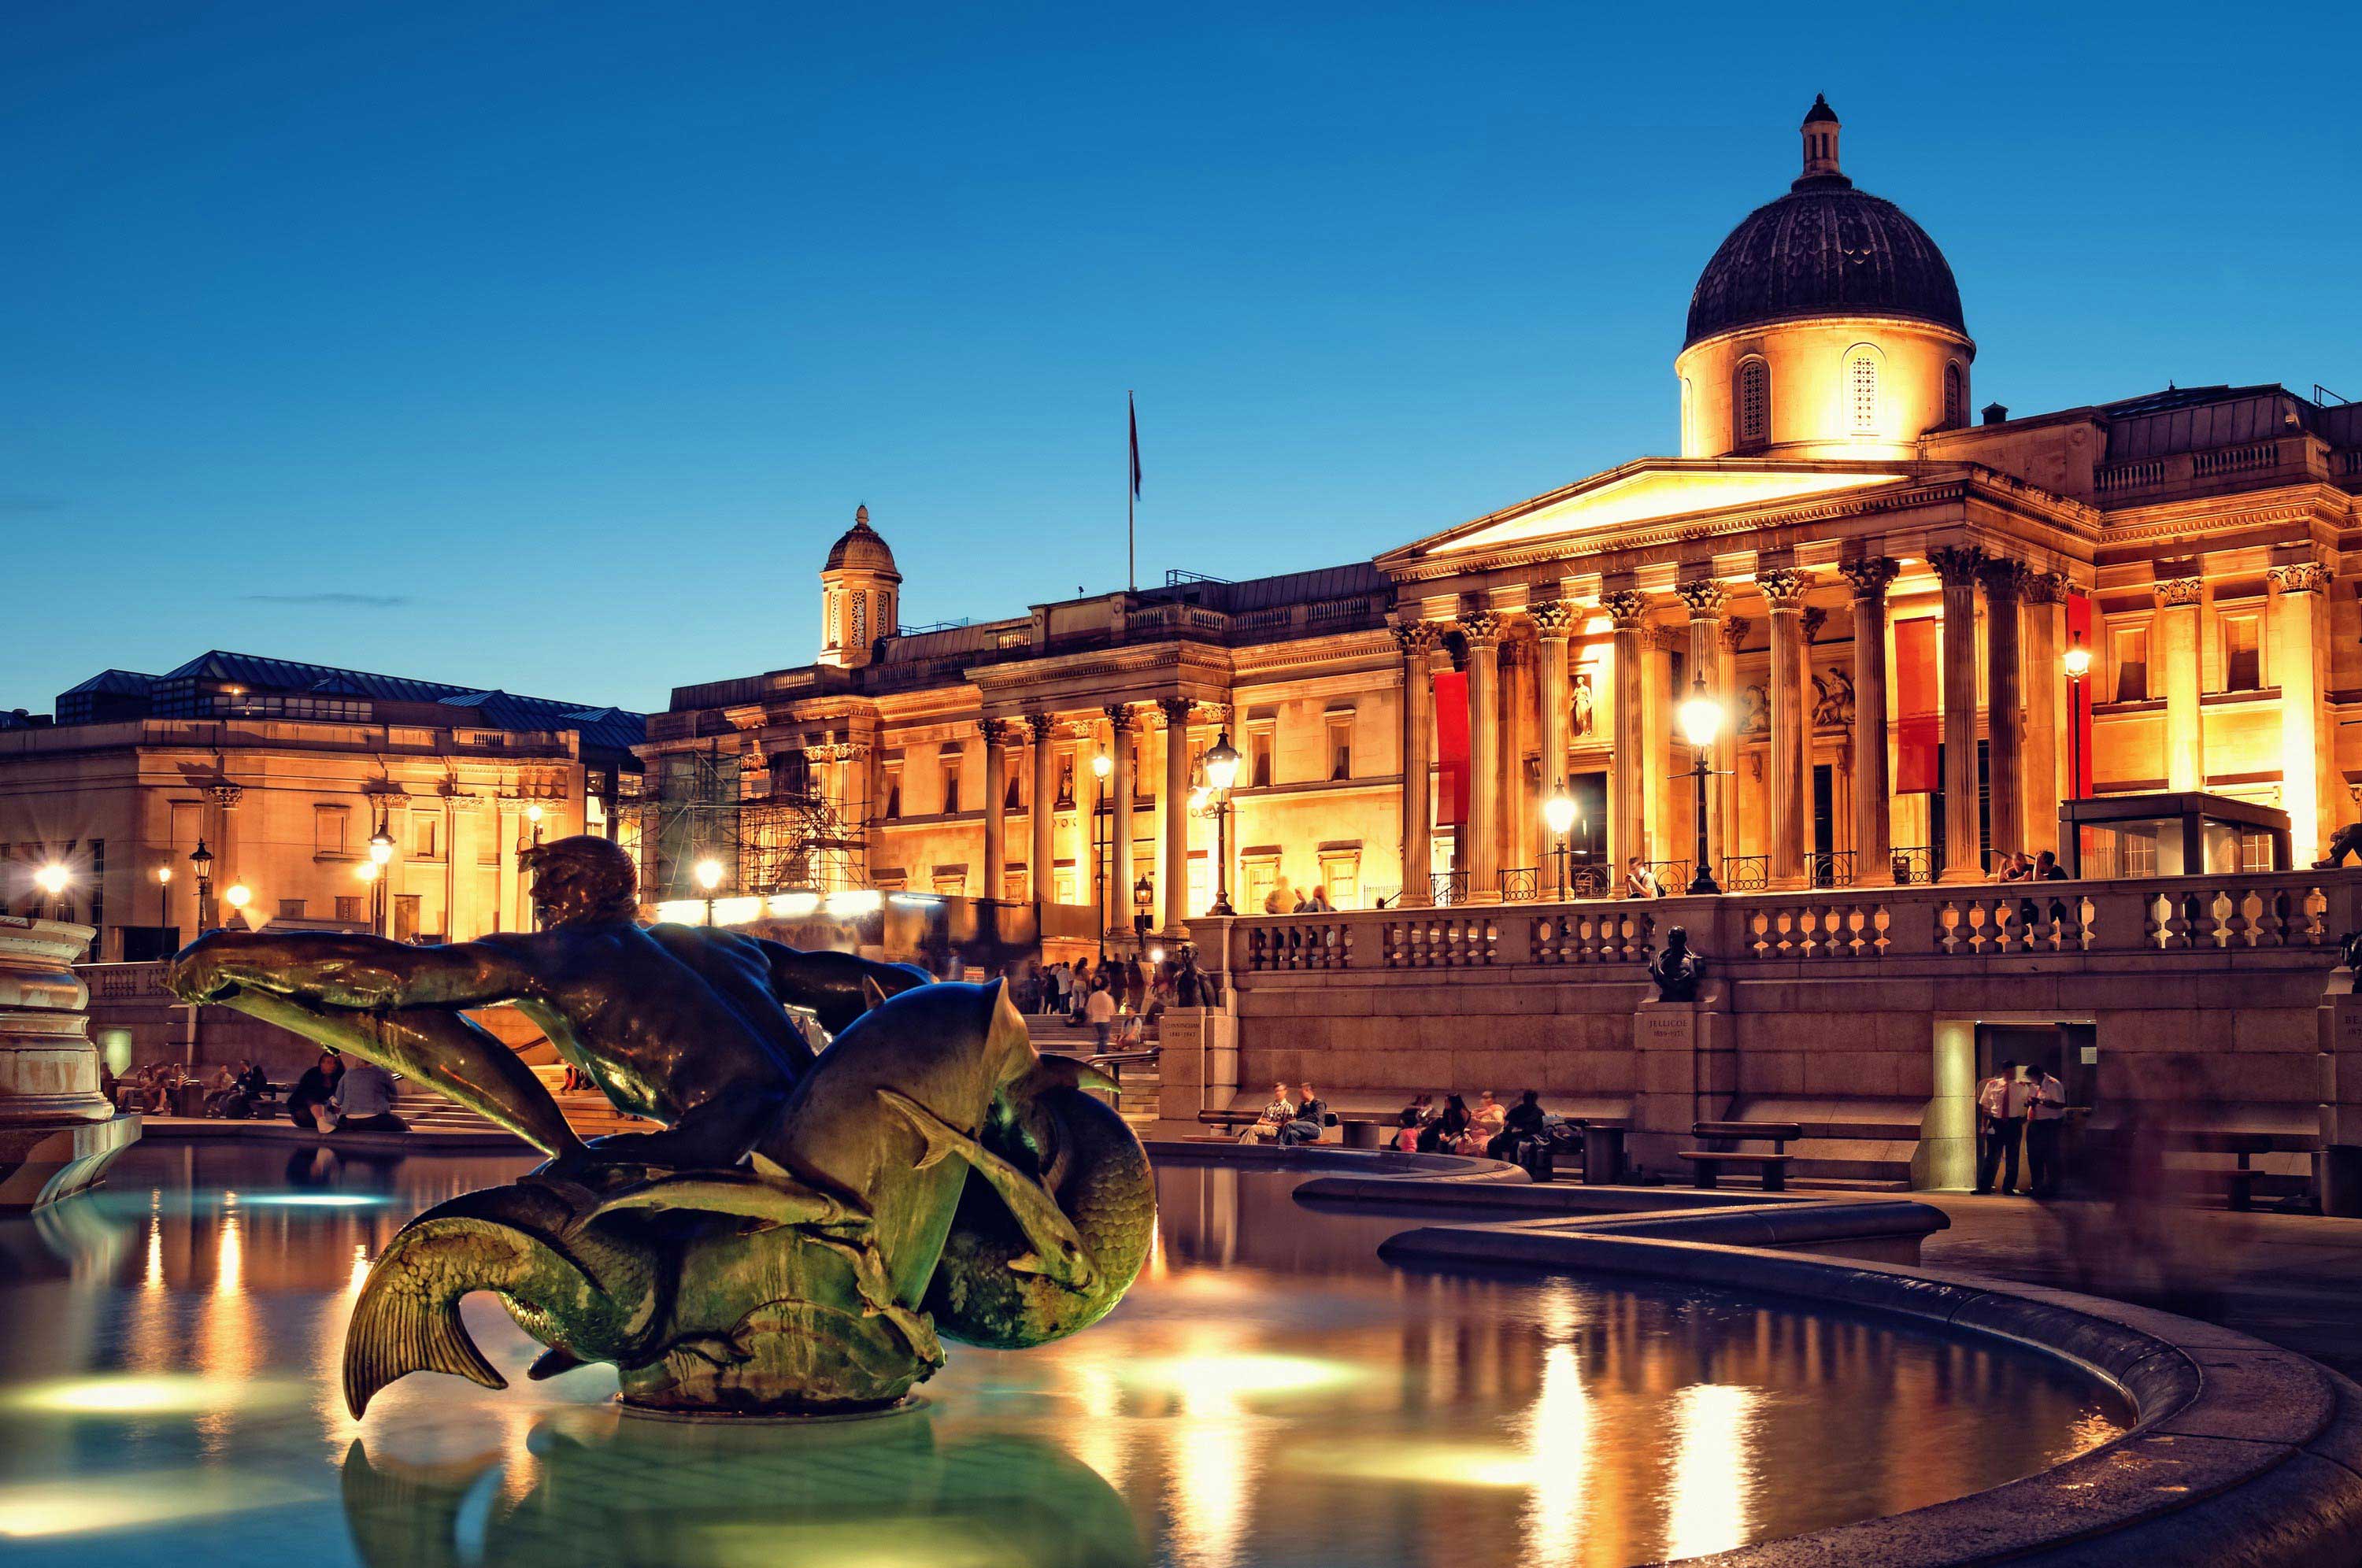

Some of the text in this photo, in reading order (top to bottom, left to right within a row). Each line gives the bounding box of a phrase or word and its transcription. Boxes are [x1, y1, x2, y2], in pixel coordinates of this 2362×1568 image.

[1503, 524, 1822, 584] THE NATIONAL GALLERY
[1649, 1019, 1688, 1028] JELLICOE
